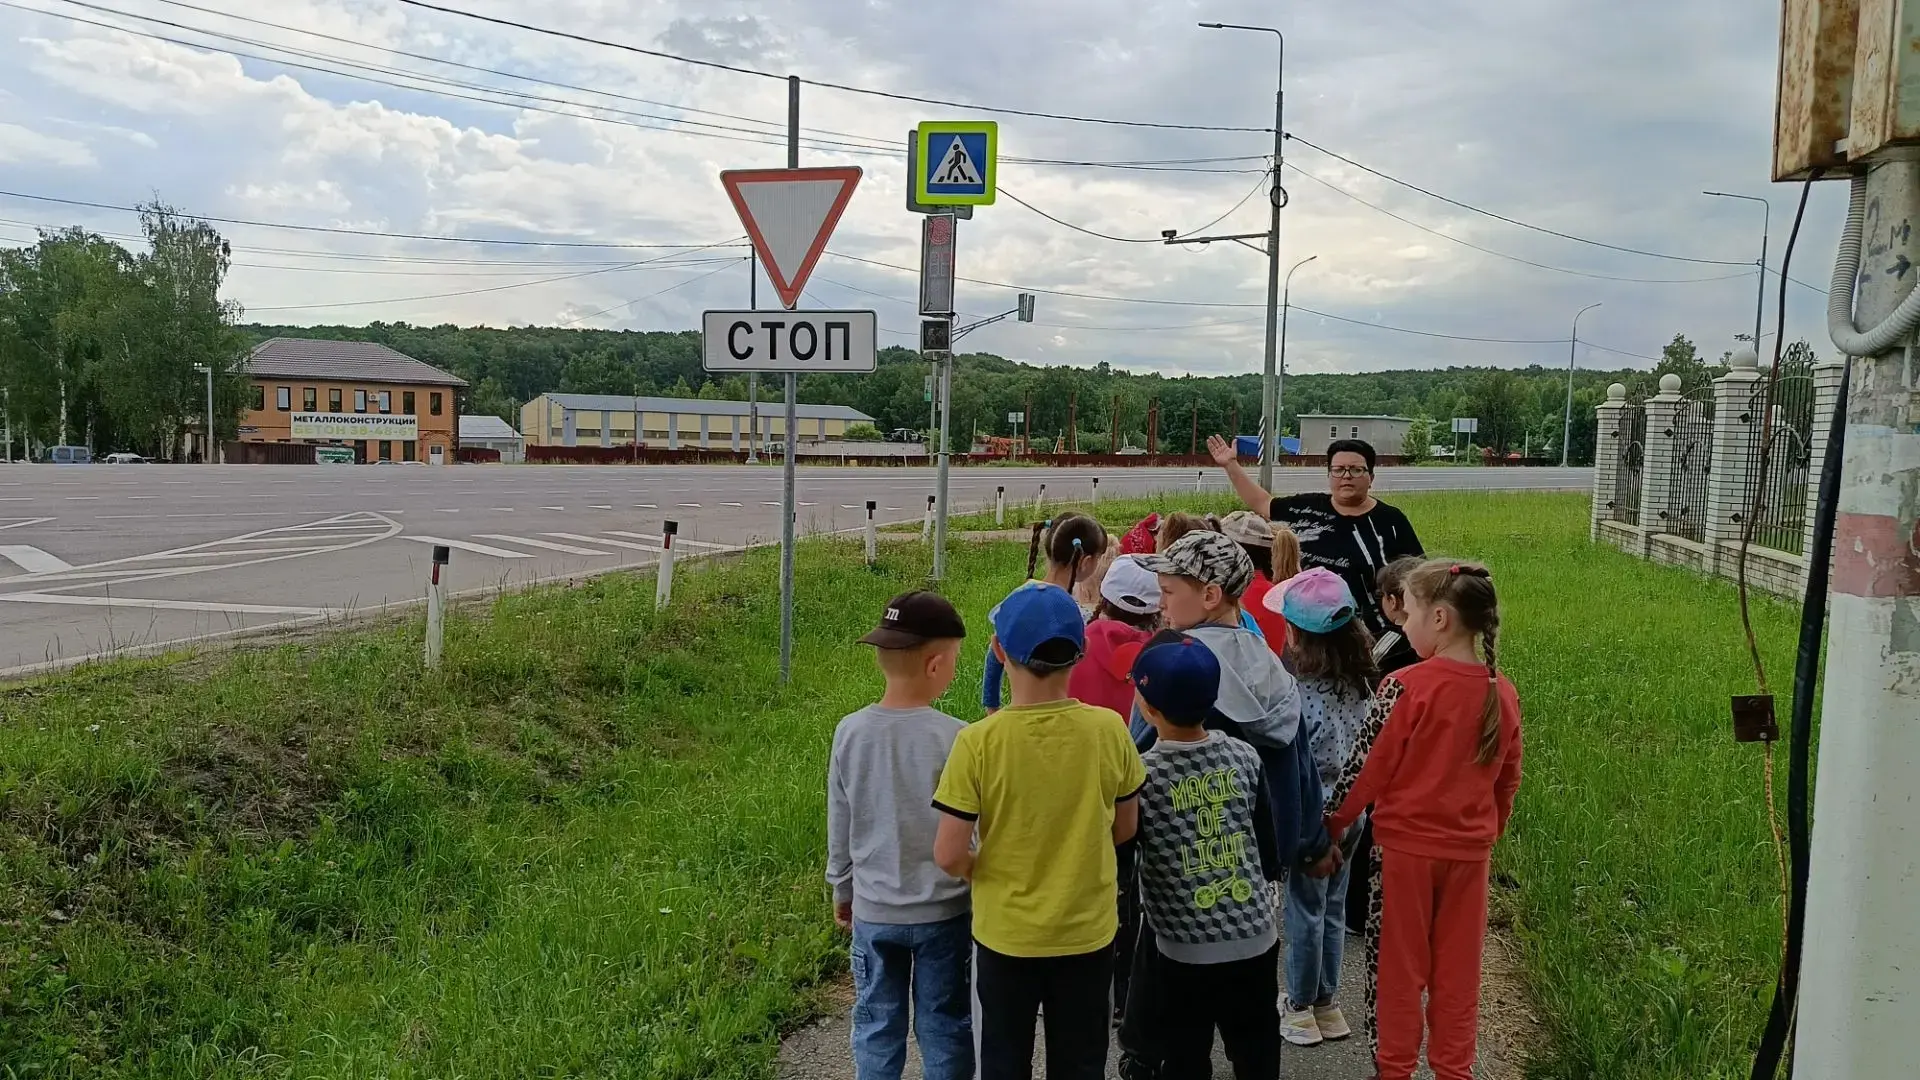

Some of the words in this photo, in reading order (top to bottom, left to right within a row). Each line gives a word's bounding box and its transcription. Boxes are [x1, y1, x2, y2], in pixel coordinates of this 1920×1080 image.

[727, 320, 850, 361] СТОП
[293, 415, 416, 425] МЕТАЛЛОКОНСТРУКЦИИ
[294, 425, 346, 434] БЕТОН
[884, 607, 900, 621] m
[1169, 767, 1243, 813] MAGIC
[1196, 802, 1227, 838] OF
[1181, 830, 1247, 875] LIGHT
